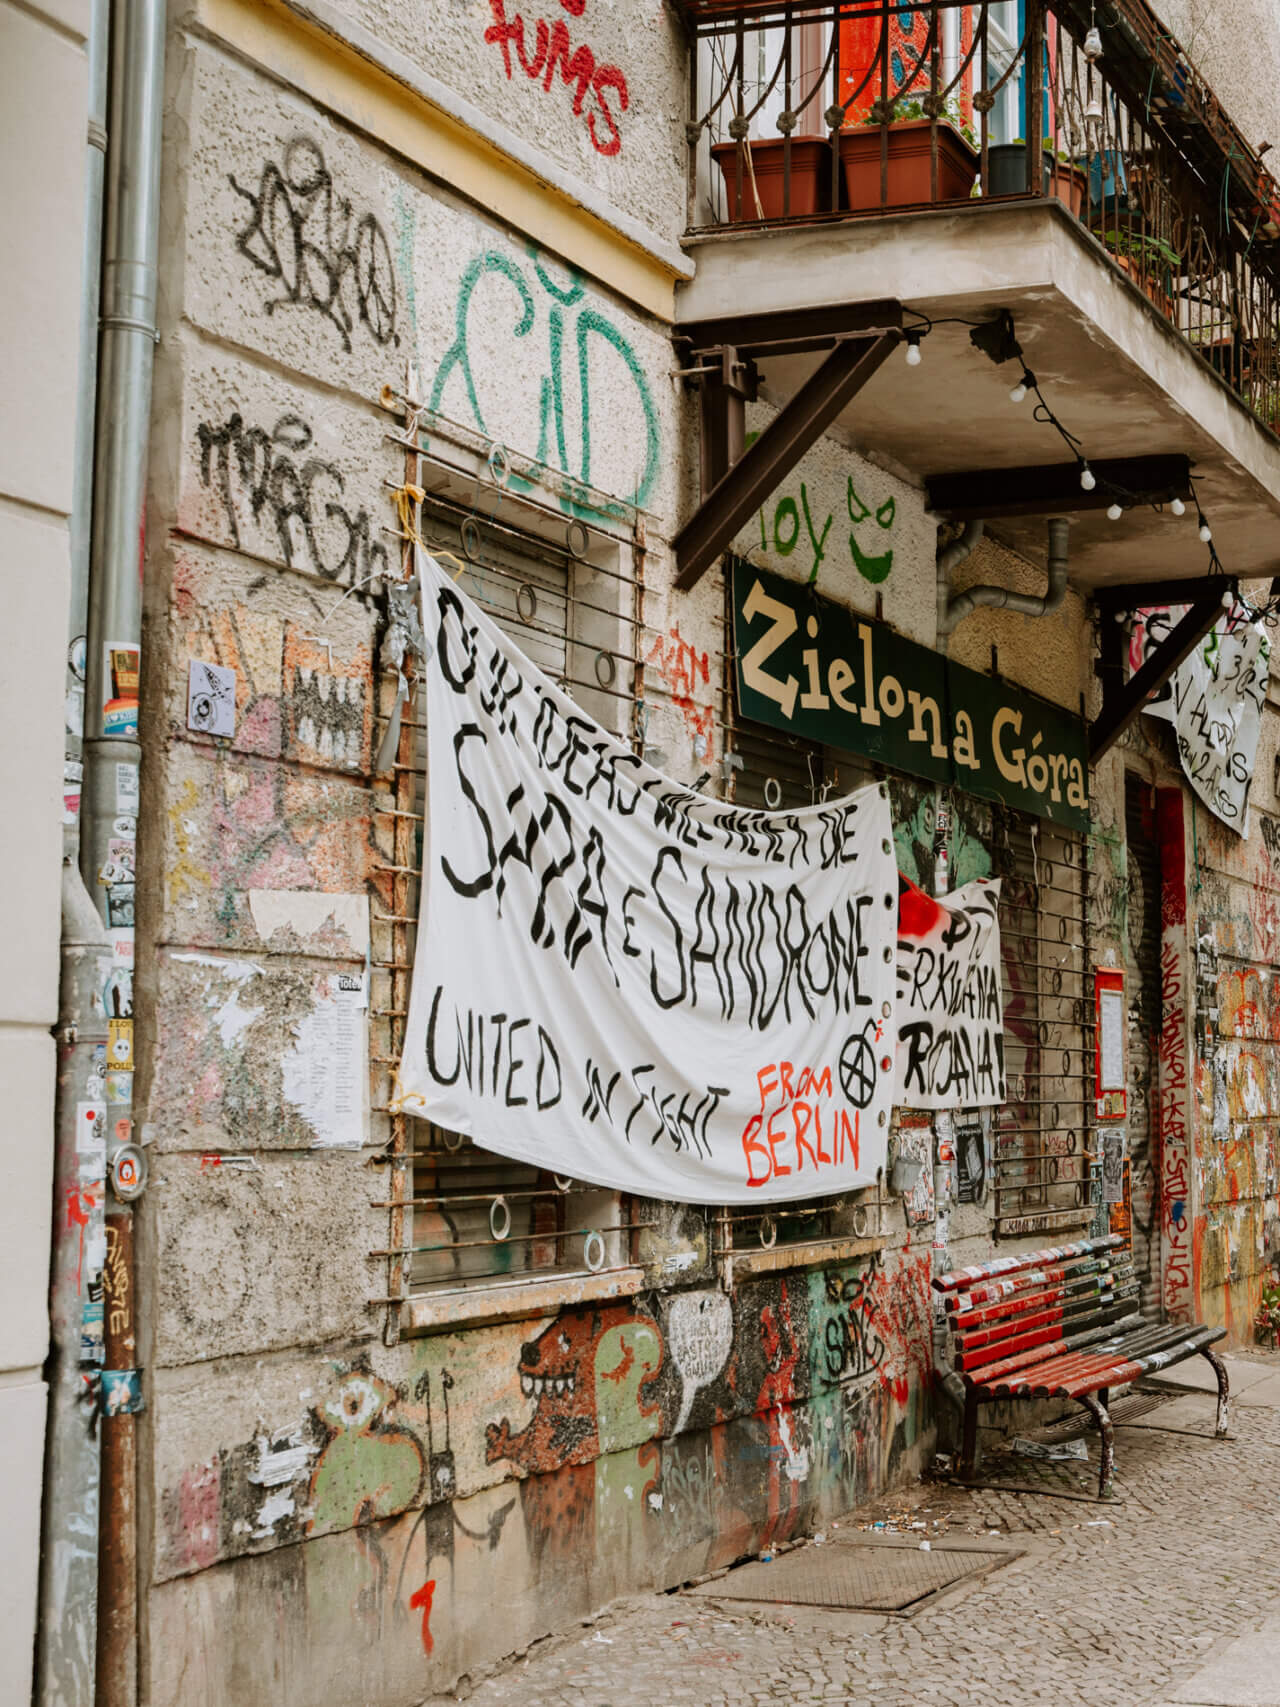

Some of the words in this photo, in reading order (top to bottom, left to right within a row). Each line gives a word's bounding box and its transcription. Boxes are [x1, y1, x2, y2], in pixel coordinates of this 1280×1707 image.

[437, 586, 524, 748] OUR
[532, 685, 662, 817] IDEAS
[654, 792, 714, 849] WILL
[817, 804, 859, 870] DIE
[741, 579, 981, 771] Zielona
[991, 706, 1089, 810] Góra
[649, 845, 874, 1032] SANDRONE
[426, 984, 563, 1110] UNITED
[580, 1057, 622, 1126] IN
[624, 1063, 731, 1160] FIGHT
[741, 1101, 861, 1188] BERLIN
[755, 1060, 834, 1114] FROM
[898, 1020, 1005, 1101] ROJAVA!
